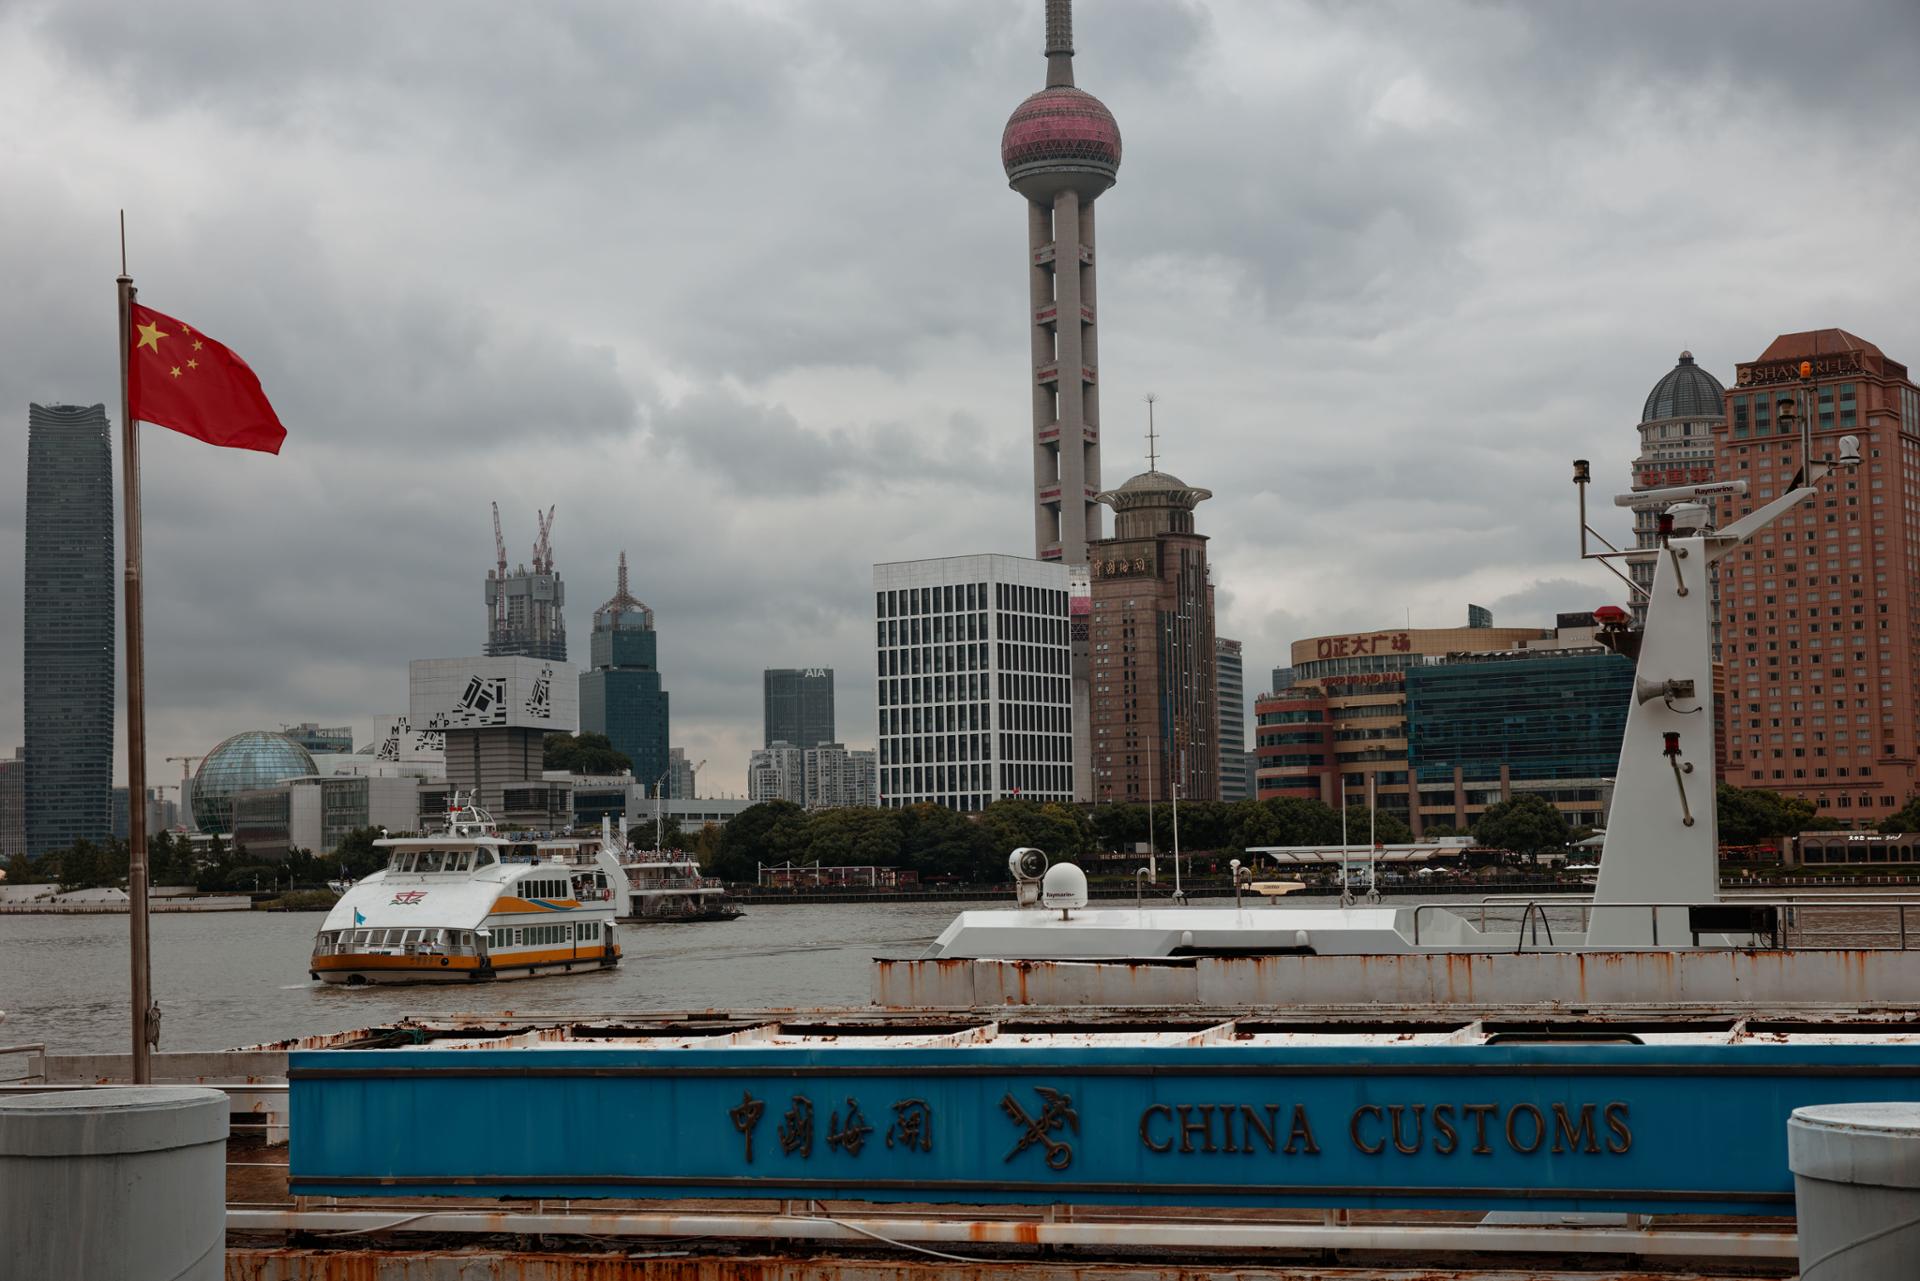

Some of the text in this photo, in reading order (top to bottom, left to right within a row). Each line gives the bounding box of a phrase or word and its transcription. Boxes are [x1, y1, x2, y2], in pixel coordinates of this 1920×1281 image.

[1755, 357, 1859, 380] SHANRI-LA
[1694, 486, 1734, 496] Raymarine
[804, 668, 826, 678] AIA
[1347, 673, 1381, 684] BRAND
[1139, 1101, 1633, 1156] CHINA CUSTOMS
